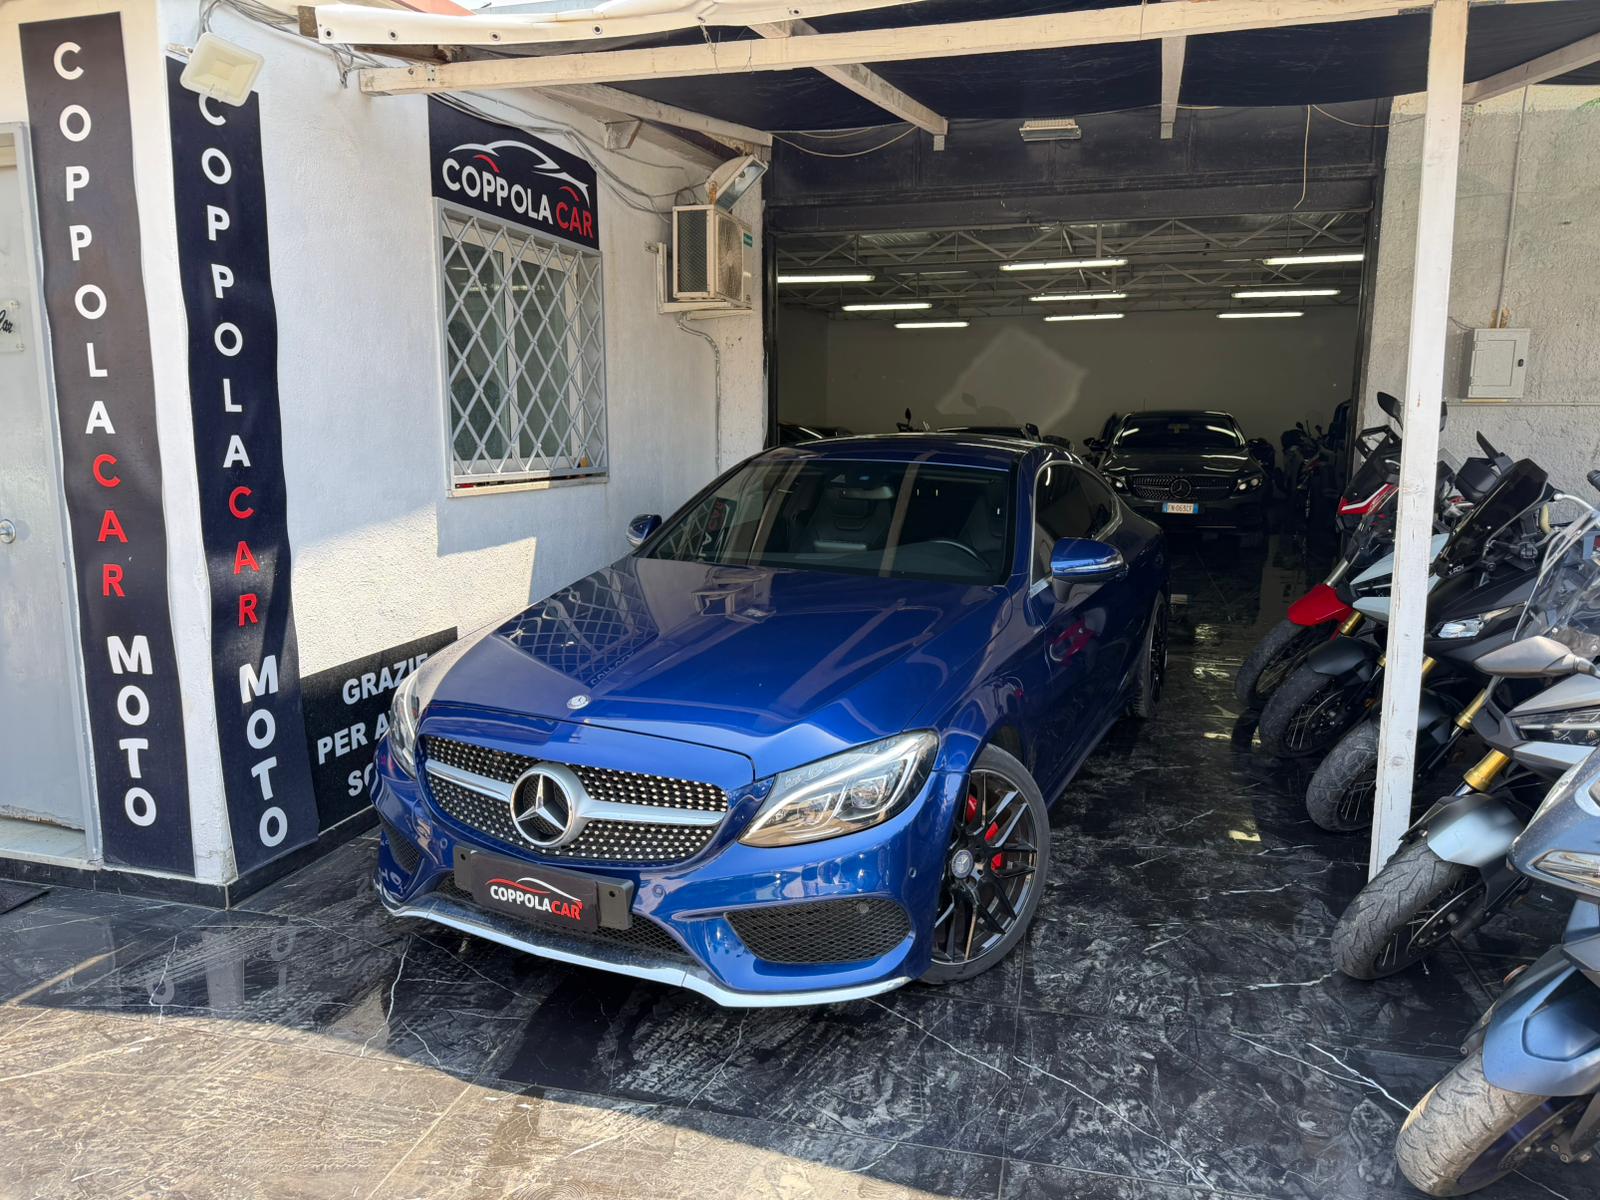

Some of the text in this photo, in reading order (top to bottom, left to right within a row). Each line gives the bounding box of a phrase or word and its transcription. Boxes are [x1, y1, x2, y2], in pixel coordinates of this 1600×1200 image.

[106, 635, 157, 827] MOTO
[239, 654, 289, 848] MOTO
[317, 710, 391, 765] PER A
